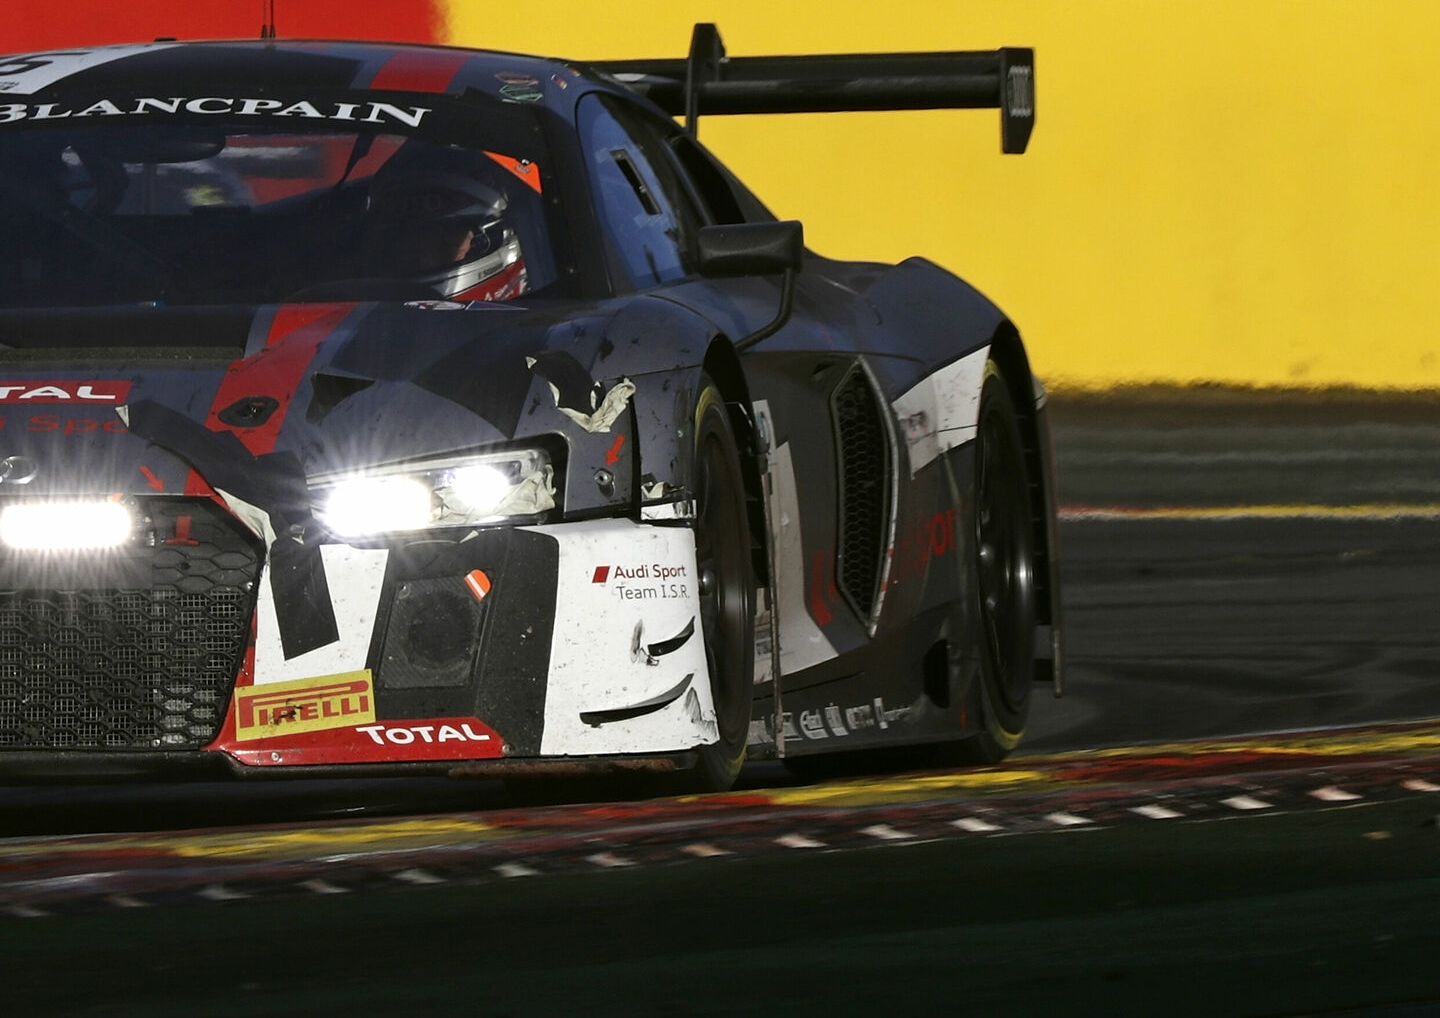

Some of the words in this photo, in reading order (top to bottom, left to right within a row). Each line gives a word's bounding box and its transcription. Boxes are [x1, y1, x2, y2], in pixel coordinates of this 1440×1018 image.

[26, 414, 130, 436] Spo
[614, 565, 649, 579] Audi
[652, 564, 687, 581] Sport
[615, 585, 658, 600] Team
[660, 584, 691, 599] I.S.R.
[239, 680, 369, 728] PIRELLI
[355, 724, 491, 745] TOTAL
